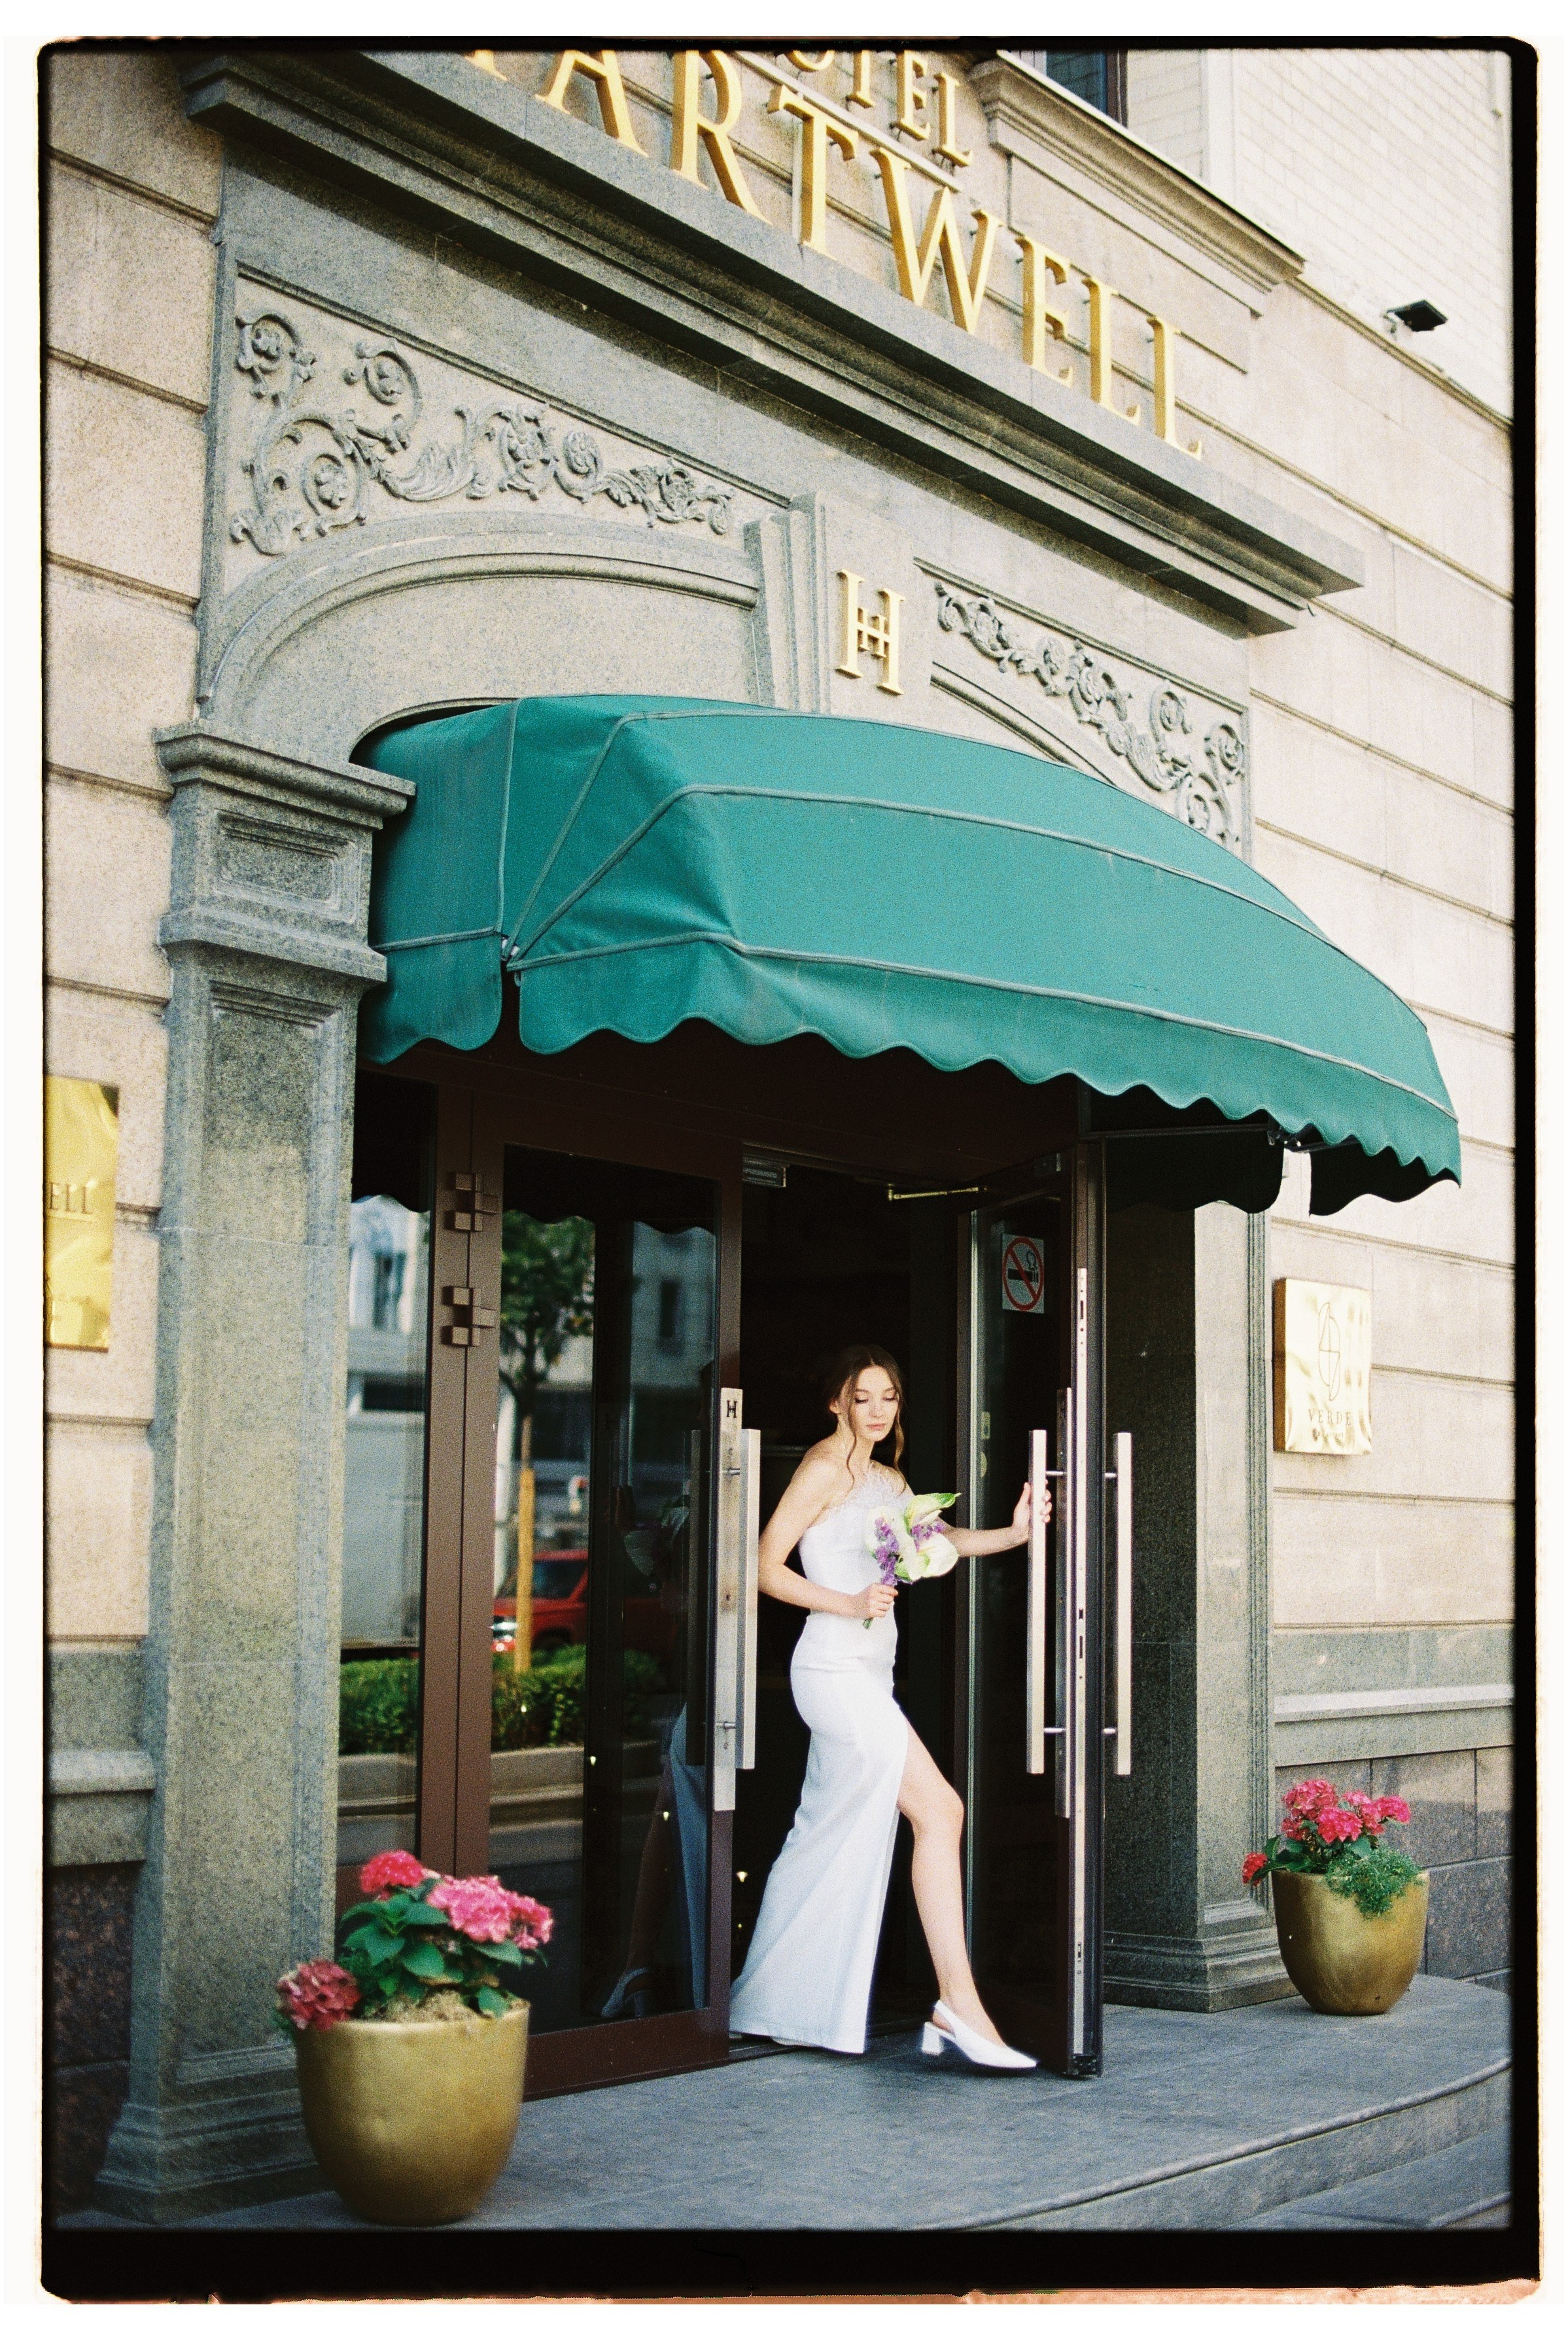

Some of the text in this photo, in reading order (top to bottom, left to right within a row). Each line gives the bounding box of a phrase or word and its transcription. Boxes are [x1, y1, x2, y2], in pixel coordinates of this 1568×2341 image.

[786, 48, 973, 167] TEL
[464, 48, 1202, 460] ARTWELL
[1308, 1408, 1352, 1426] VERDE
